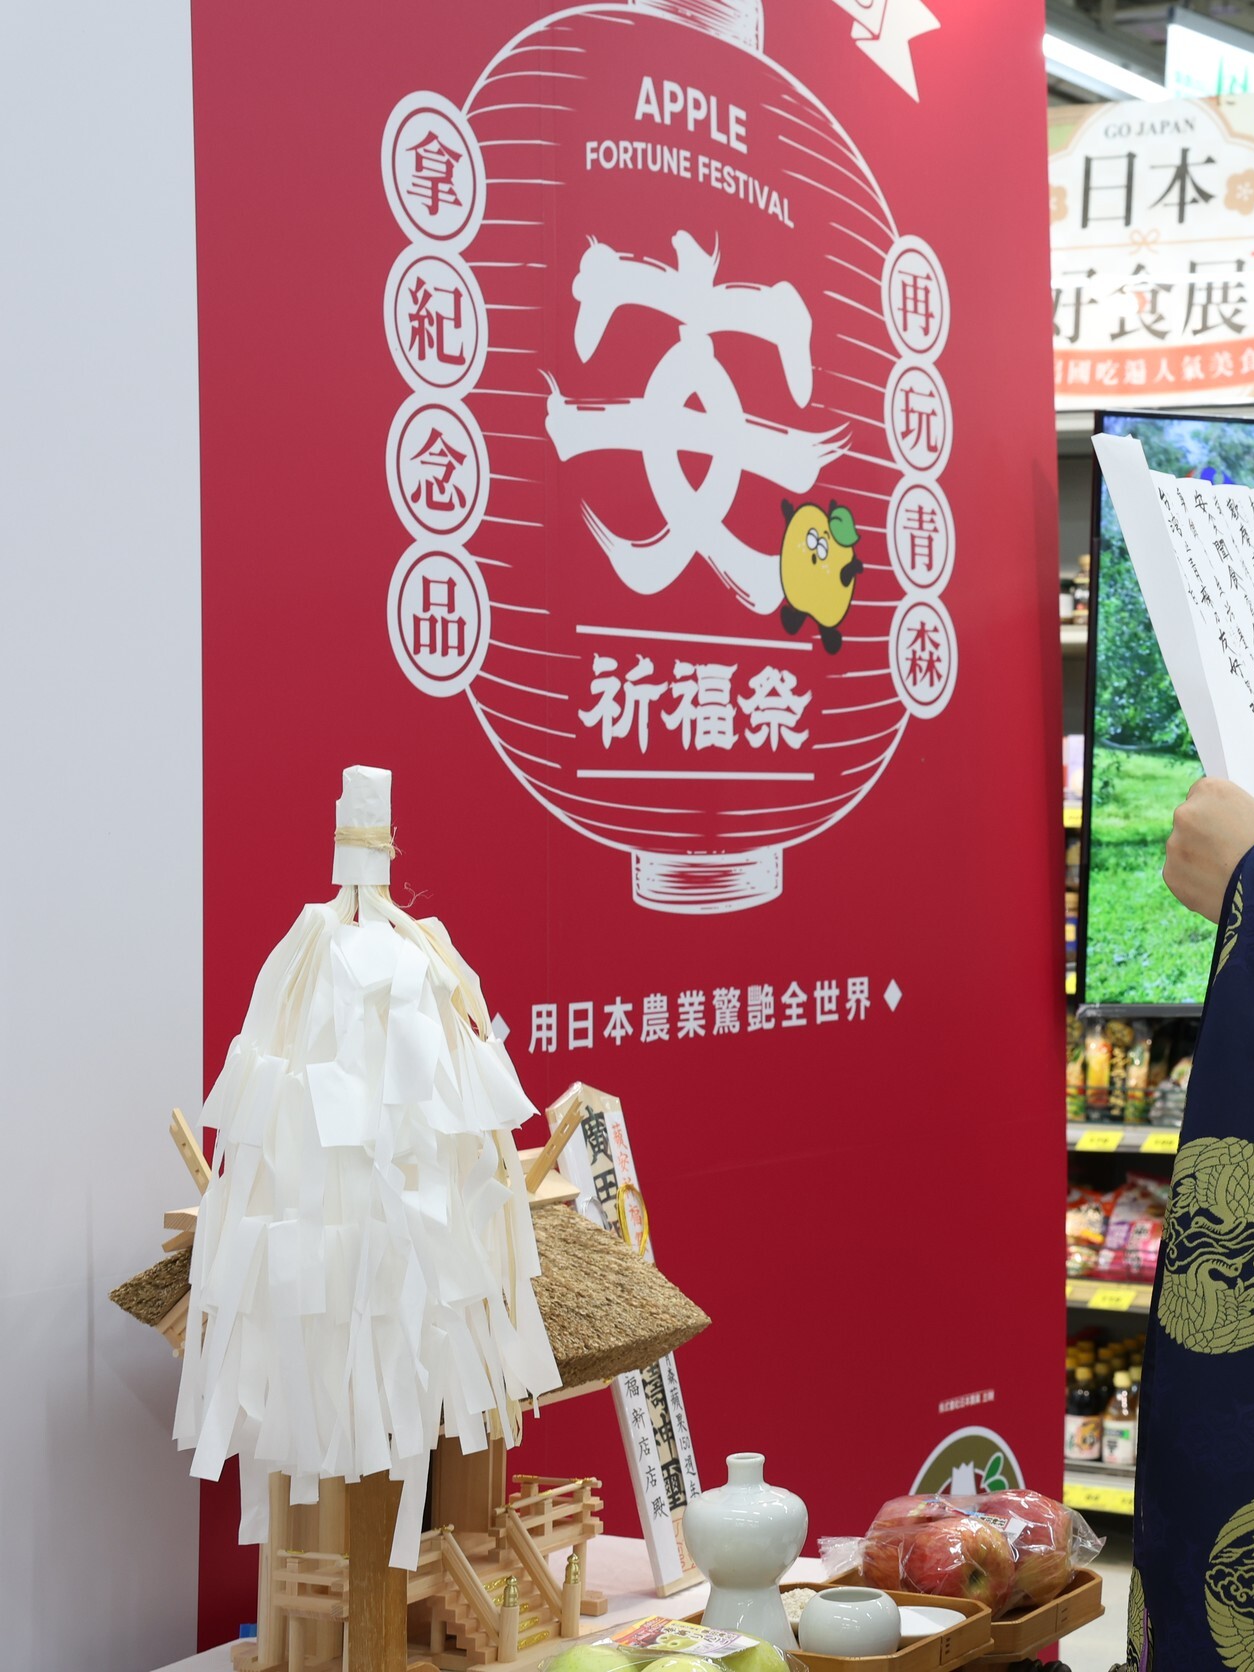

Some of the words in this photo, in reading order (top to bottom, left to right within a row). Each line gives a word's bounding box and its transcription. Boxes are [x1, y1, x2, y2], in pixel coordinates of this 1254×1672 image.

[635, 76, 748, 153] APPLE
[1104, 122, 1133, 139] GO
[1136, 117, 1195, 137] JAPAN
[585, 140, 693, 178] FORTUNE
[698, 153, 795, 228] FESTIVAL
[1081, 147, 1217, 229] 日本
[405, 130, 467, 658] 拿紀念品
[537, 229, 853, 615] 安
[896, 270, 944, 687] 再玩青森
[578, 653, 812, 753] 祈福祭
[528, 976, 871, 1054] 用日本農業驚艷全世界
